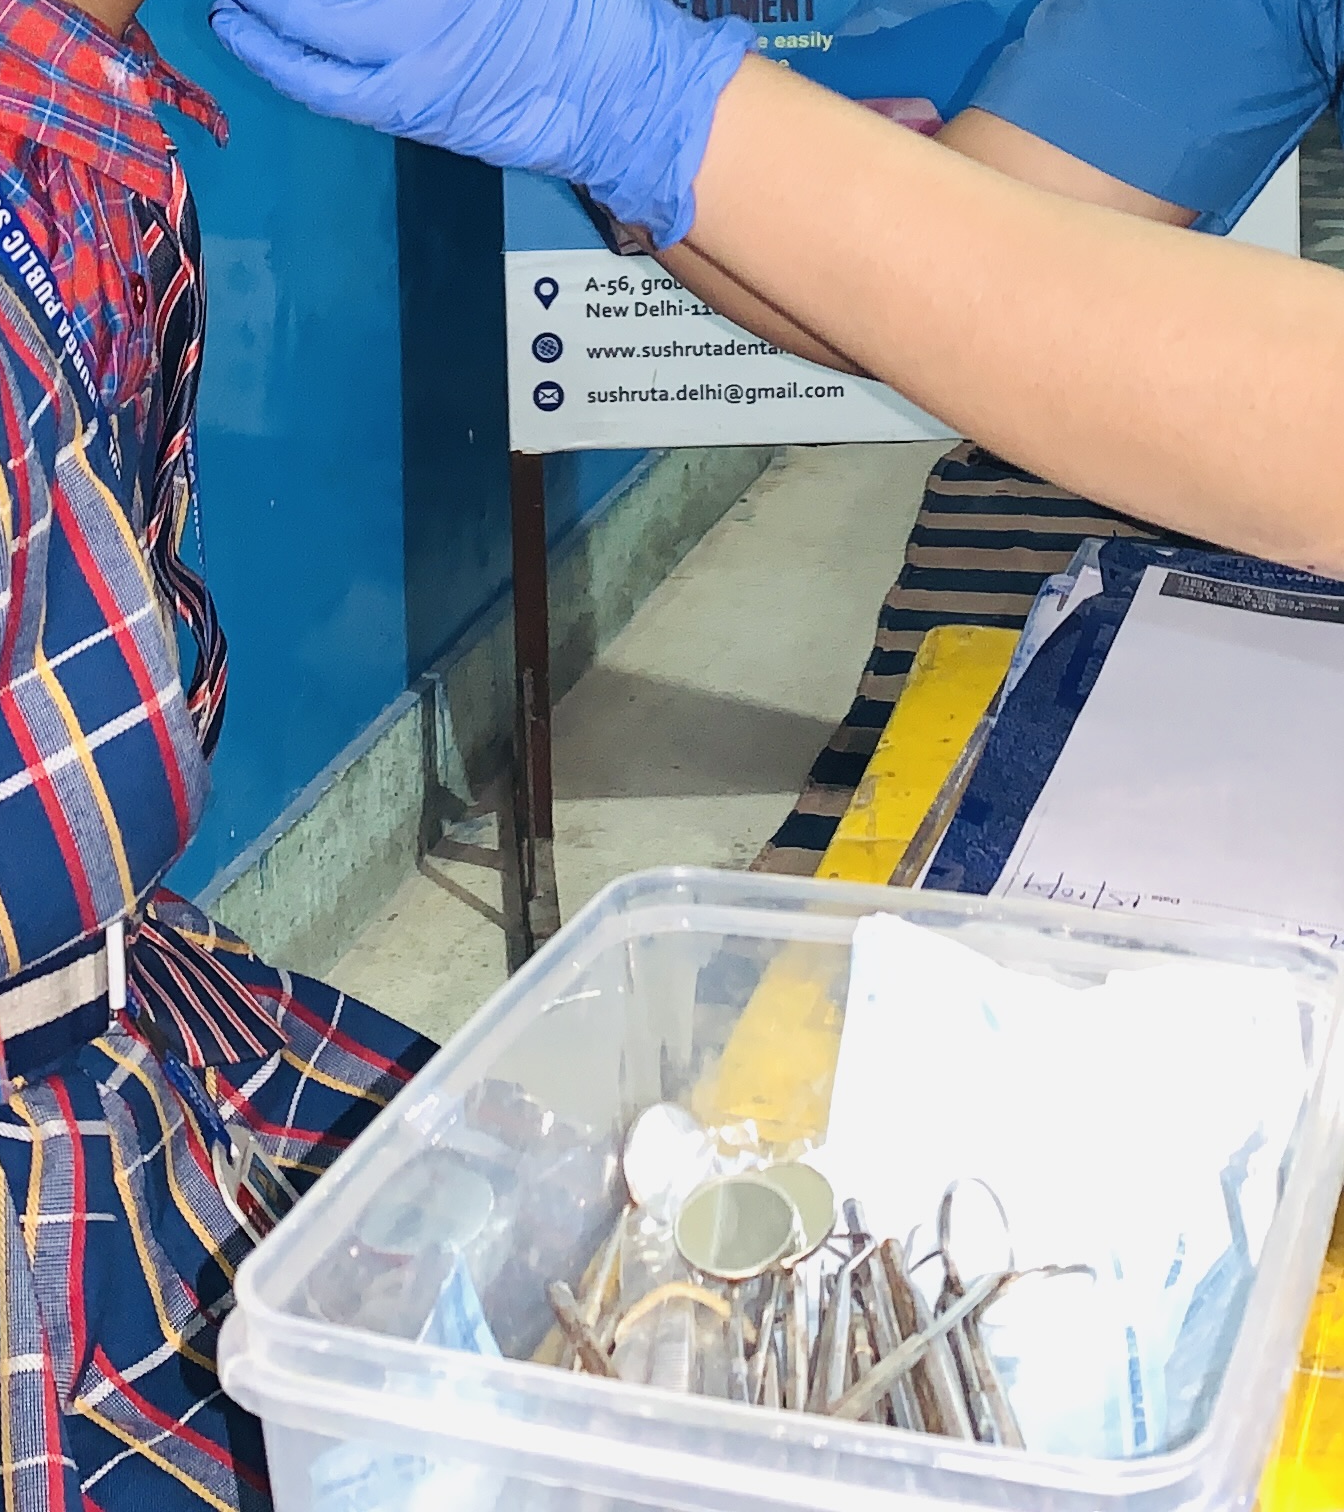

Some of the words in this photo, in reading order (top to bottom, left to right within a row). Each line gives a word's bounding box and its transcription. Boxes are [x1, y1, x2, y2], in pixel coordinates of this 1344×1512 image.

[774, 32, 834, 52] easily
[1, 228, 68, 322] PUBLIC
[585, 275, 635, 296] A-56,
[585, 301, 629, 318] New
[587, 381, 845, 405] sushruta.delhi@gmail.com
